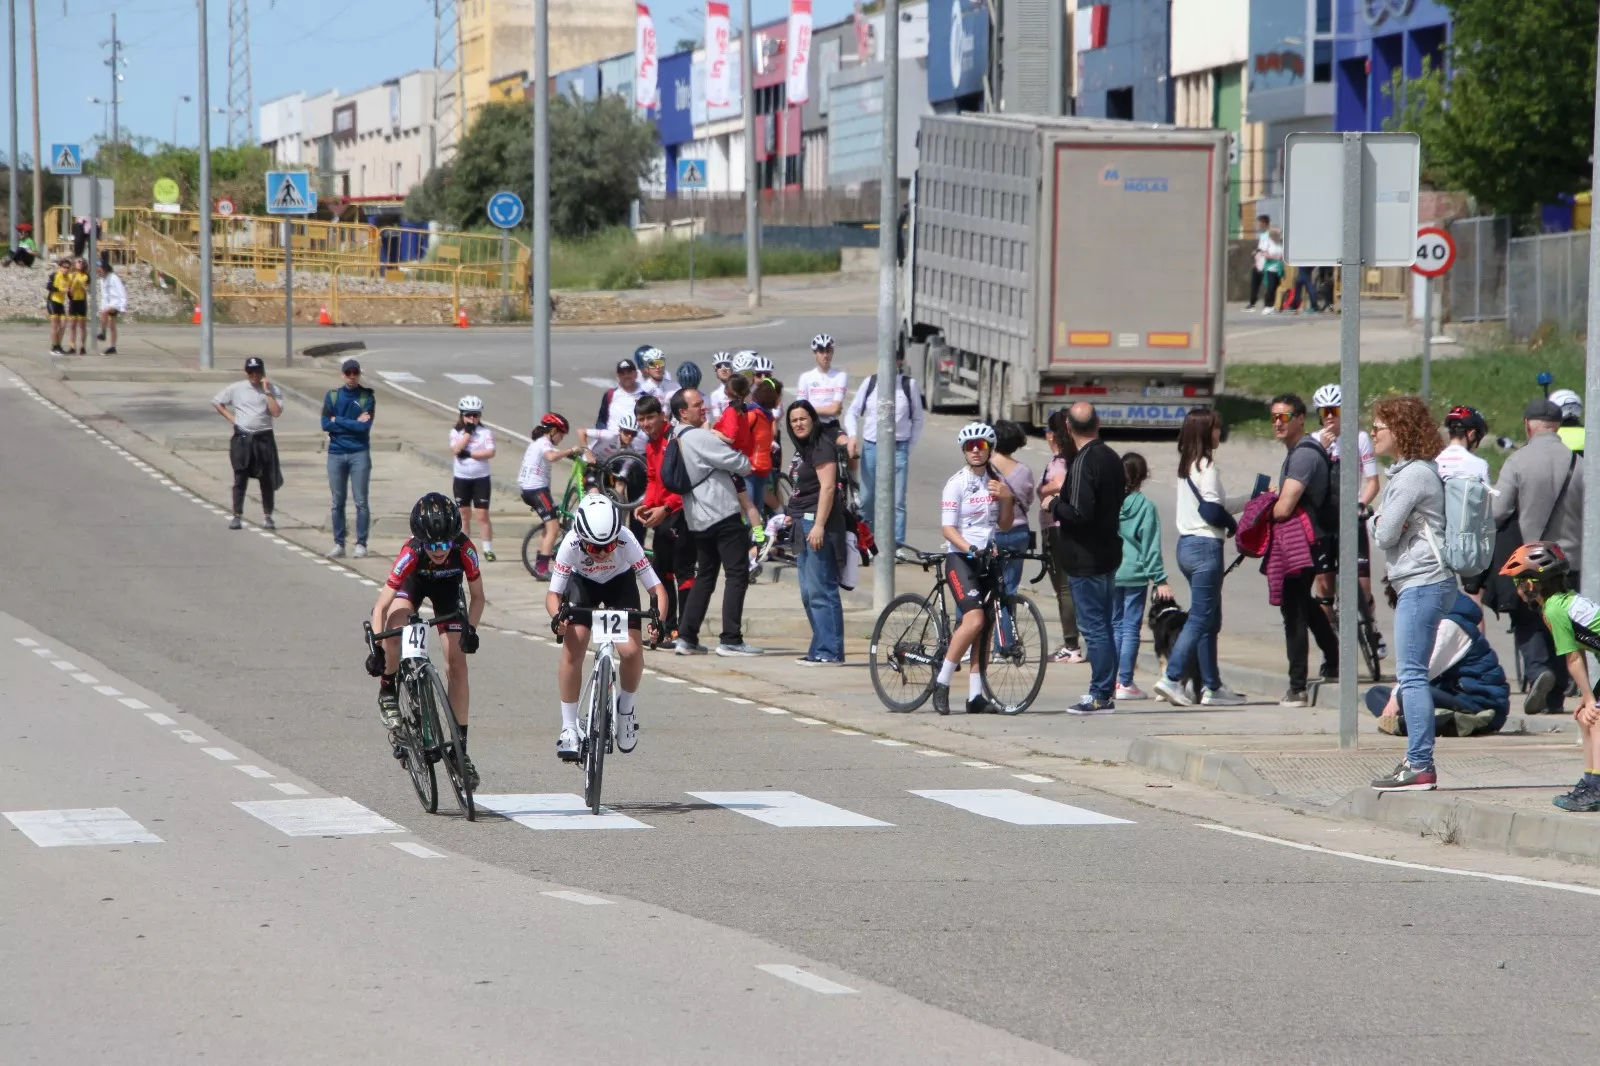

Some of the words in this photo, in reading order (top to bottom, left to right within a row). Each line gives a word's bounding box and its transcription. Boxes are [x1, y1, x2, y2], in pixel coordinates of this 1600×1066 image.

[1123, 182, 1169, 192] MOLAS
[1417, 244, 1446, 260] 40
[1127, 405, 1198, 419] MOLA
[600, 613, 622, 634] 12
[408, 626, 426, 649] 42
